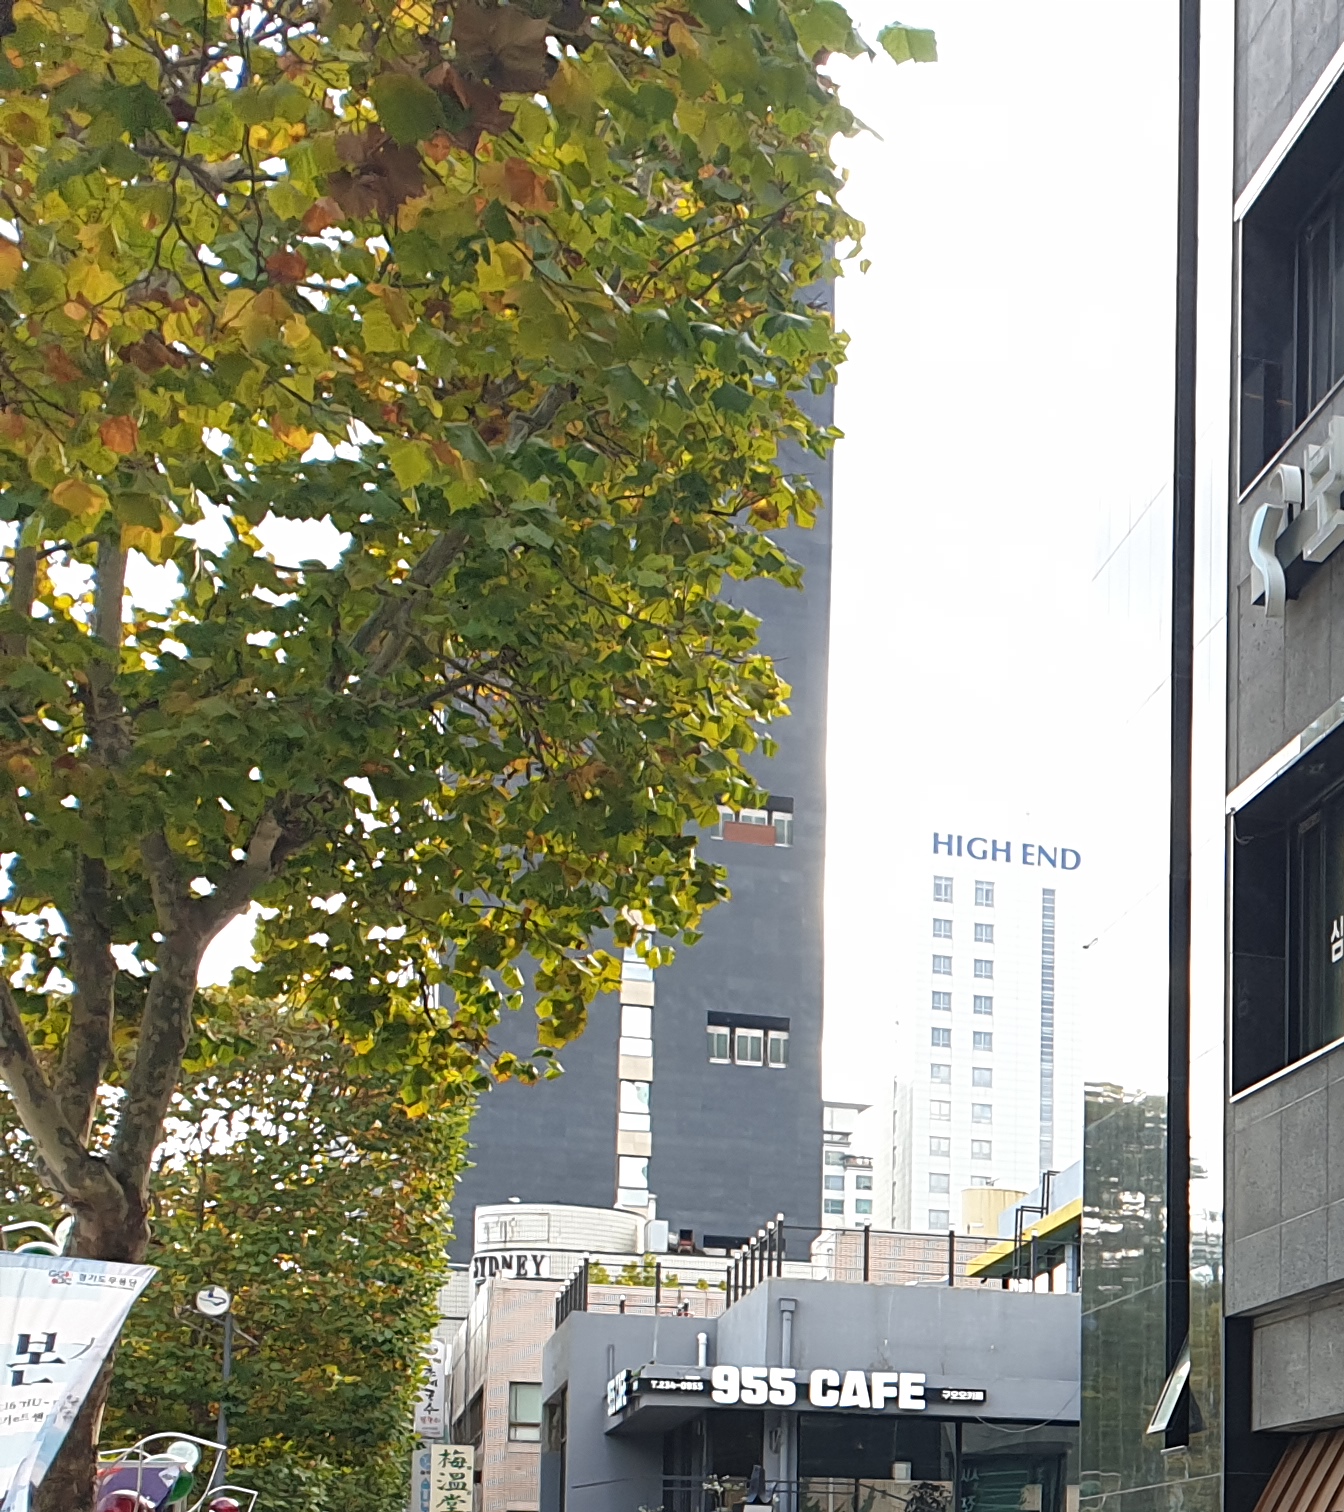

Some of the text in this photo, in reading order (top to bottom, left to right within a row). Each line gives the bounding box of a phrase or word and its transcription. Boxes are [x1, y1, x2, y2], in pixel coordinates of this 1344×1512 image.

[933, 832, 1082, 870] HIGH END
[712, 1365, 796, 1406] 955
[809, 1369, 926, 1411] CAFE
